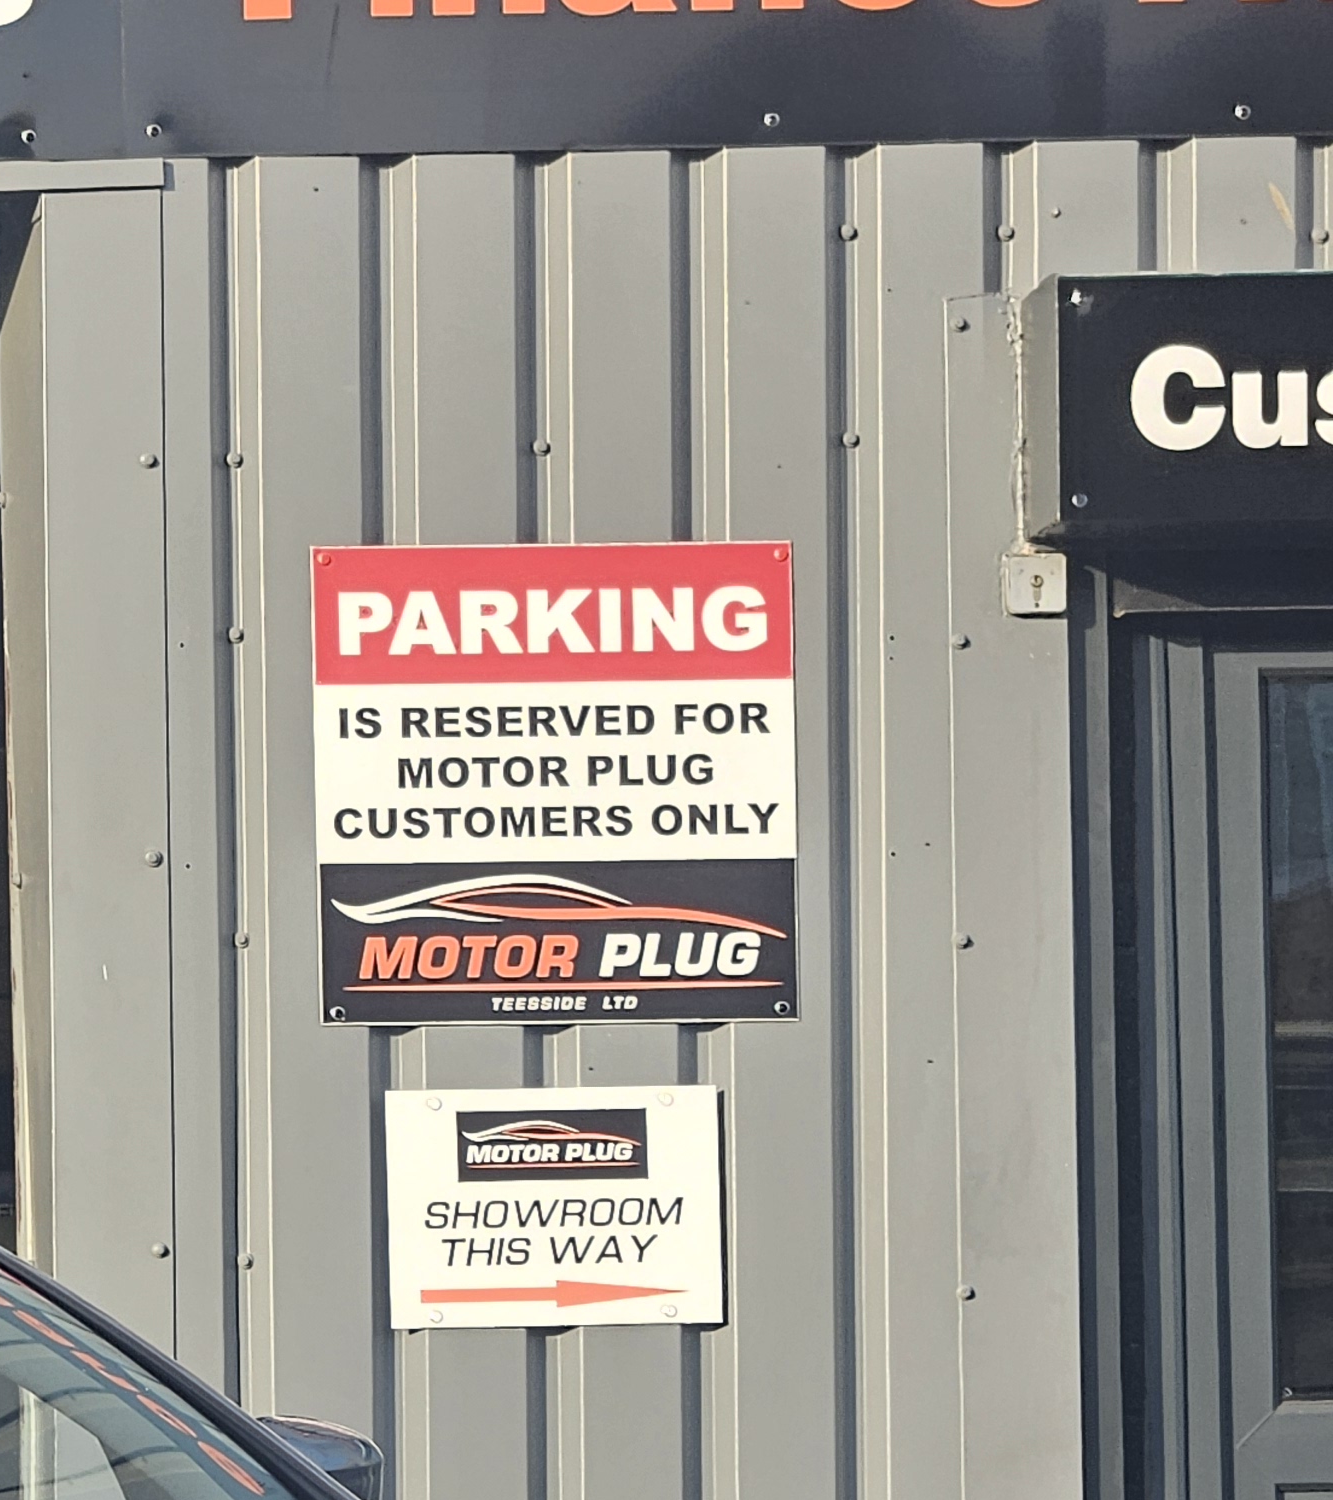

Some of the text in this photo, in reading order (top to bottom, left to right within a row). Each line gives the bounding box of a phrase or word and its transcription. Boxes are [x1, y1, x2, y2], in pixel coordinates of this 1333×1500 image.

[1130, 344, 1333, 451] Cu
[337, 585, 769, 656] PARKING
[338, 702, 770, 738] IS RESERVED FOR
[397, 753, 714, 788] MOTOR PLUG
[333, 802, 779, 839] CUSTOMERS ONLY
[358, 932, 761, 979] MOTOR PLUG
[491, 995, 638, 1012] TEESSIDE LTD
[466, 1141, 634, 1164] MOTOR PLUG
[424, 1196, 684, 1229] SHOWROOM
[441, 1234, 659, 1267] THIS WAY
